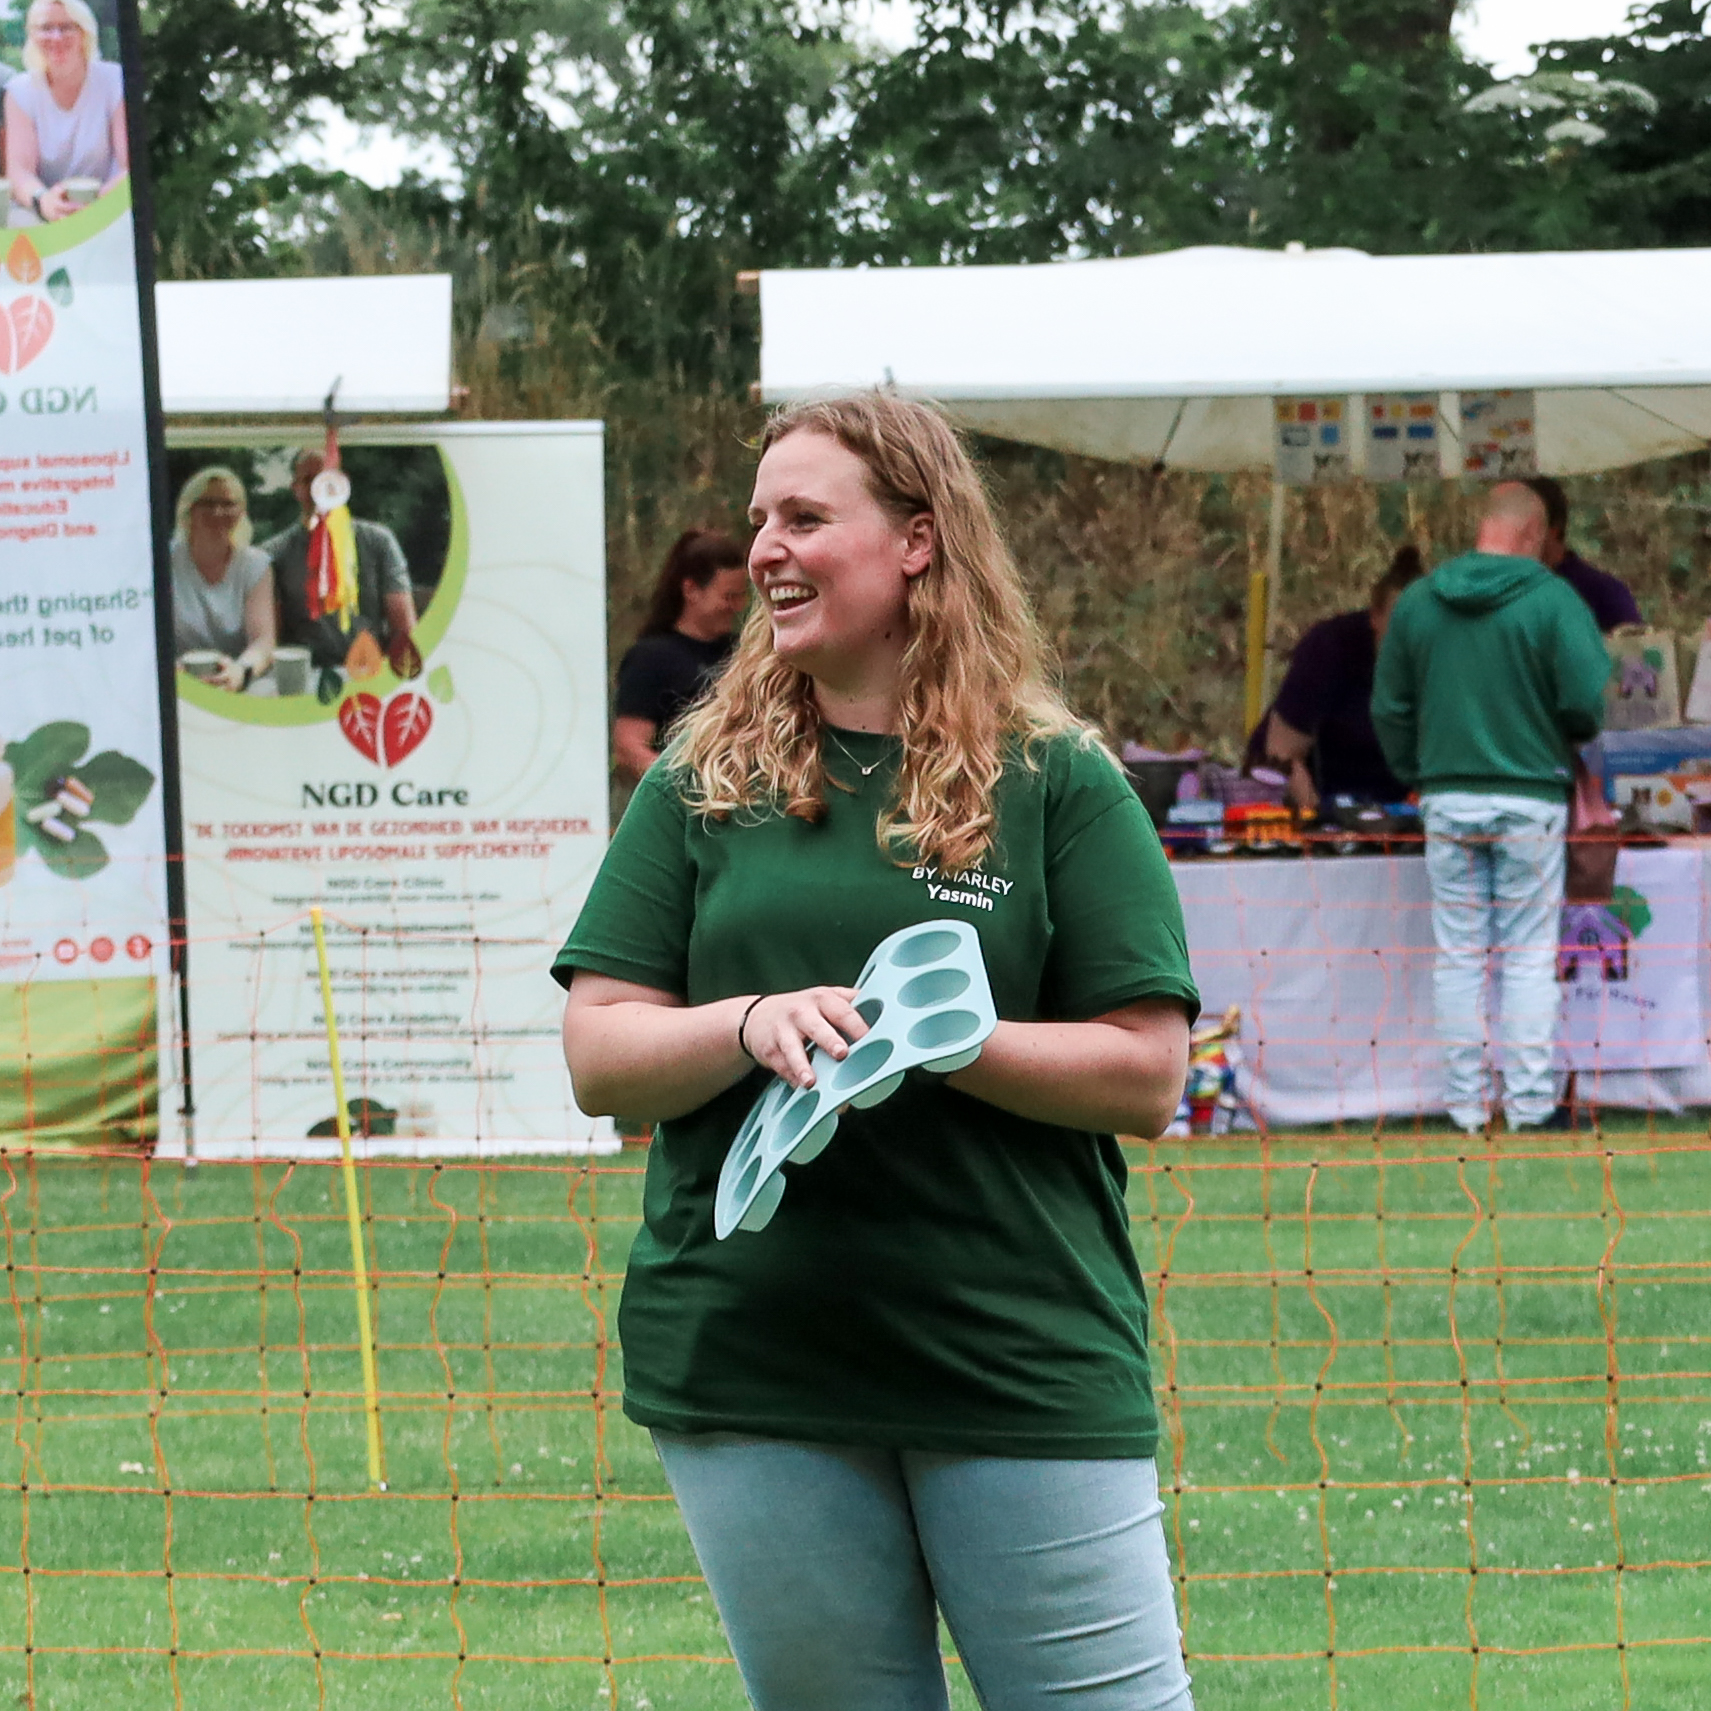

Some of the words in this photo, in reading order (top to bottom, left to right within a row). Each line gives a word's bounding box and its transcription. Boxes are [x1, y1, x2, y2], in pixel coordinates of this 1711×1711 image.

[302, 781, 379, 809] NGD
[391, 780, 469, 808] Care
[222, 822, 302, 838] TOEKOMST
[347, 821, 361, 836] DE
[371, 820, 462, 836] GEZONDHEID
[912, 866, 938, 880] BY
[927, 883, 994, 912] Yasmin
